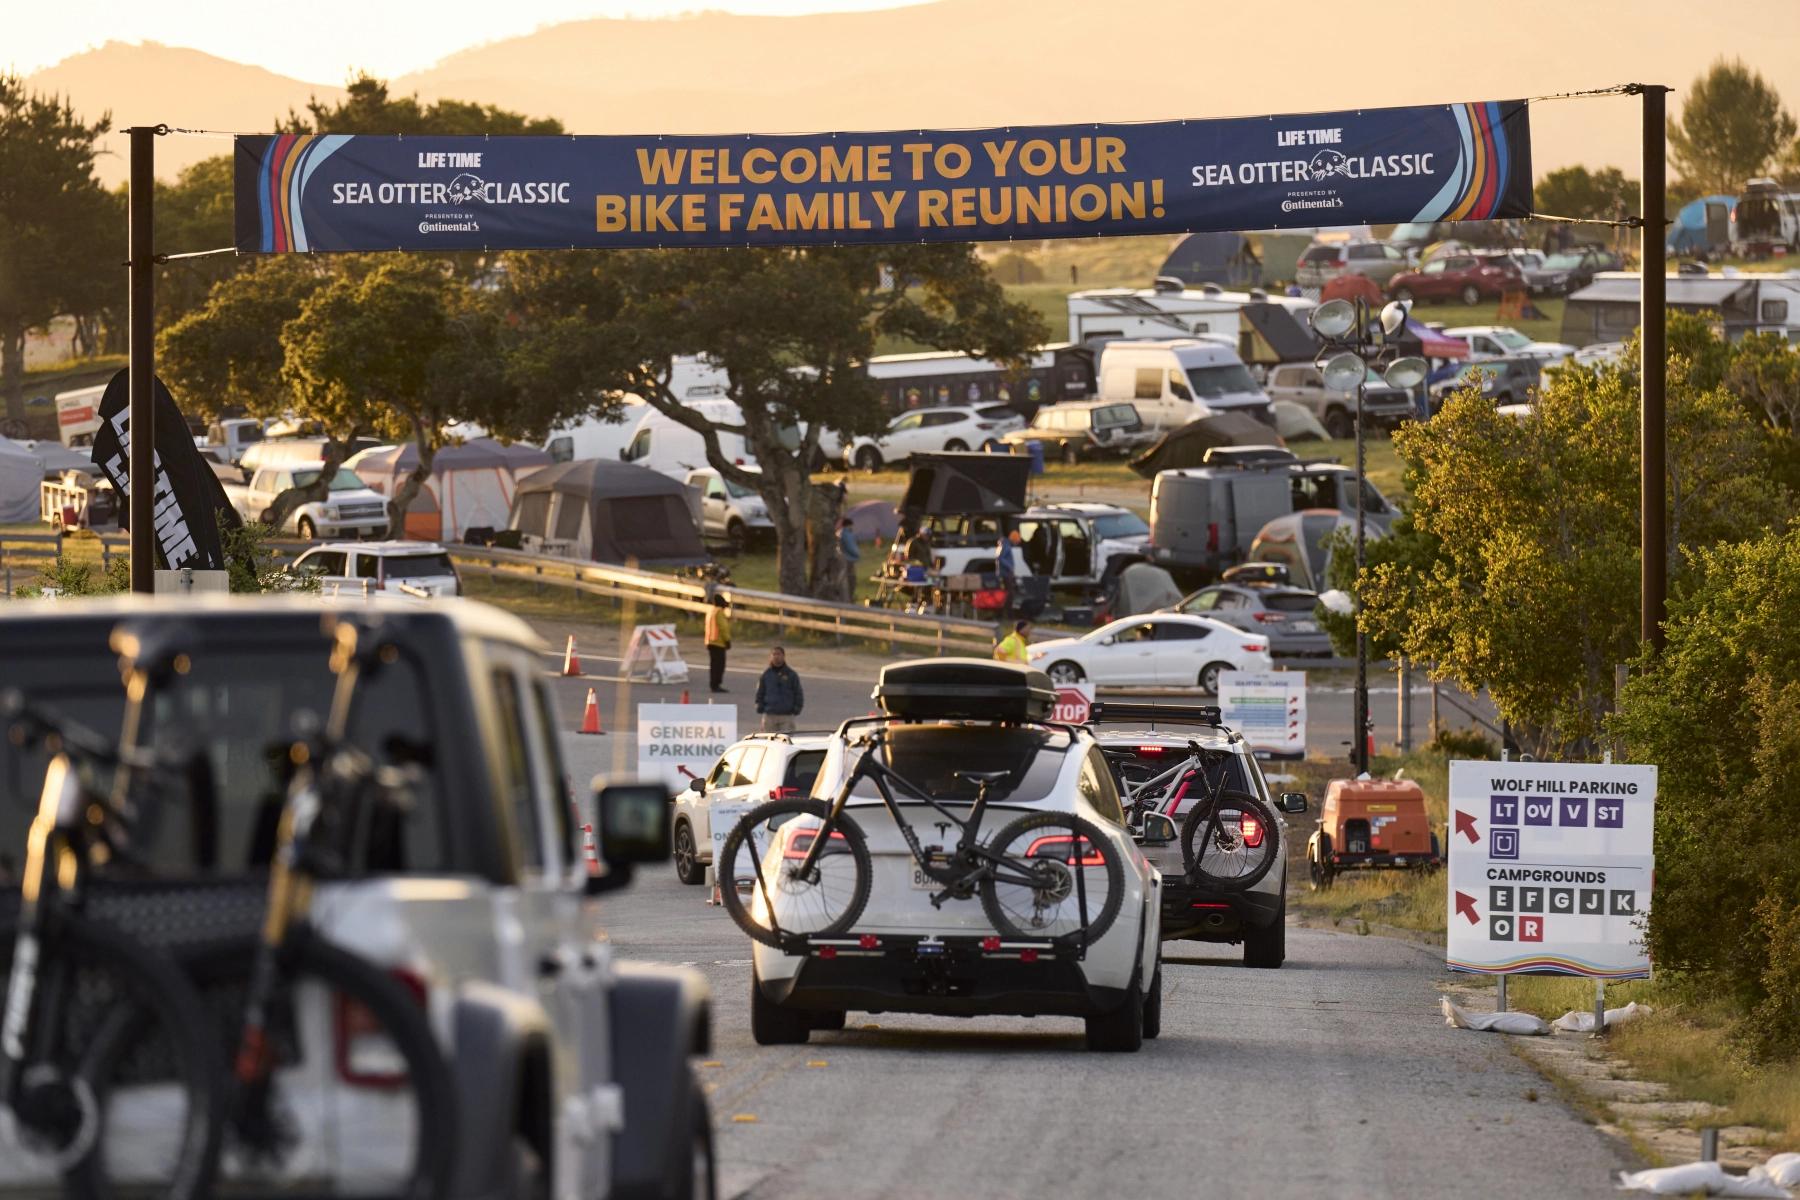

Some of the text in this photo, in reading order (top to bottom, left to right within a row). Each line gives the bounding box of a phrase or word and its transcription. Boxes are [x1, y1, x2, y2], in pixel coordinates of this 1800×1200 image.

[1277, 128, 1342, 147] LIFE TIME
[418, 152, 482, 168] LIFE TIME
[636, 136, 1127, 186] WELCOME TO YOUR
[1191, 152, 1435, 187] SEA OTTER CLASSIC
[332, 182, 570, 204] SEA OTTER CLASSIC
[595, 178, 1166, 233] BIKE FAMILY REUNION!
[1281, 198, 1335, 212] Continental
[418, 221, 471, 234] Continental
[1054, 704, 1085, 720] TOP
[650, 726, 725, 739] GENERAL
[649, 744, 725, 756] PARKING
[1491, 778, 1638, 795] WOLF HILL PARKING
[1495, 803, 1619, 821] LT OV V ST
[1486, 868, 1606, 884] CAMPGROUNDS
[1496, 890, 1632, 911] E F G J K
[1494, 919, 1538, 937] O R
